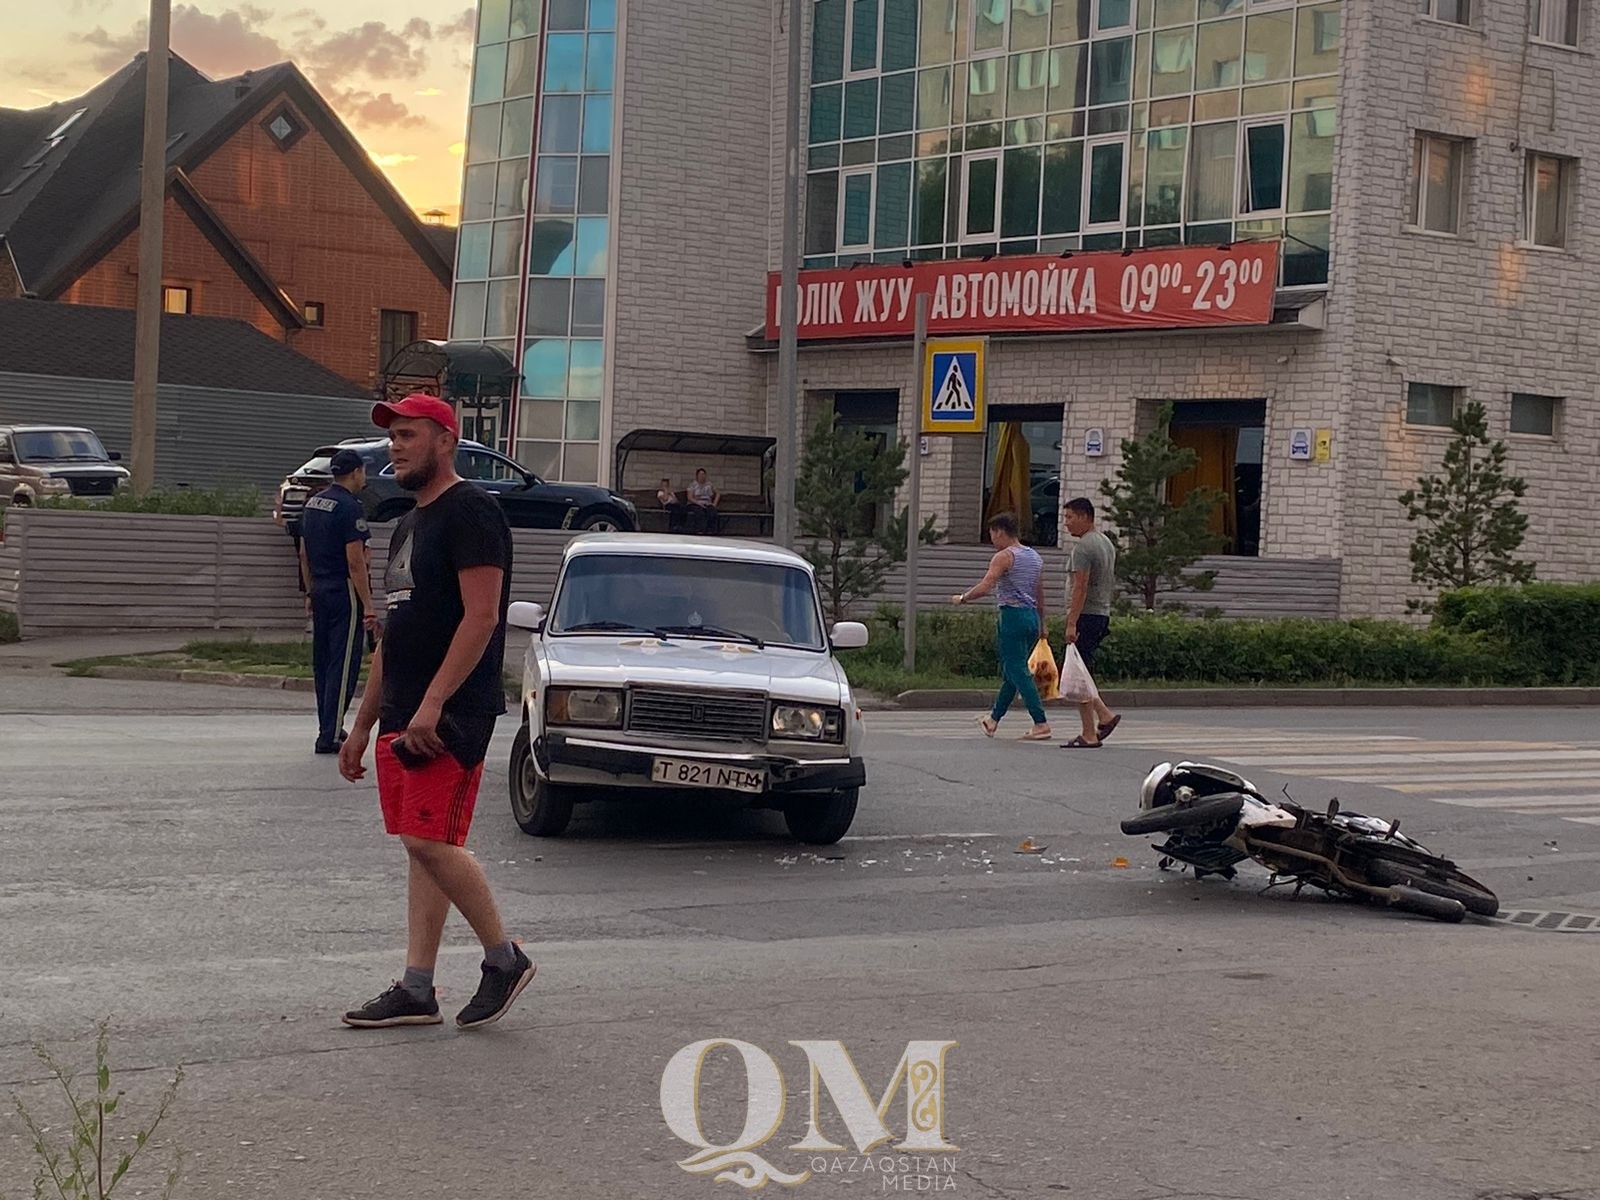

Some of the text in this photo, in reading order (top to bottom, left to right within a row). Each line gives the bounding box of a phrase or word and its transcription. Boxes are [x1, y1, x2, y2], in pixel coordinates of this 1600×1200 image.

[853, 277, 914, 322] ЖУУ
[931, 263, 1097, 319] АВТОМОЙКА
[660, 761, 673, 779] T
[678, 764, 711, 784] 821
